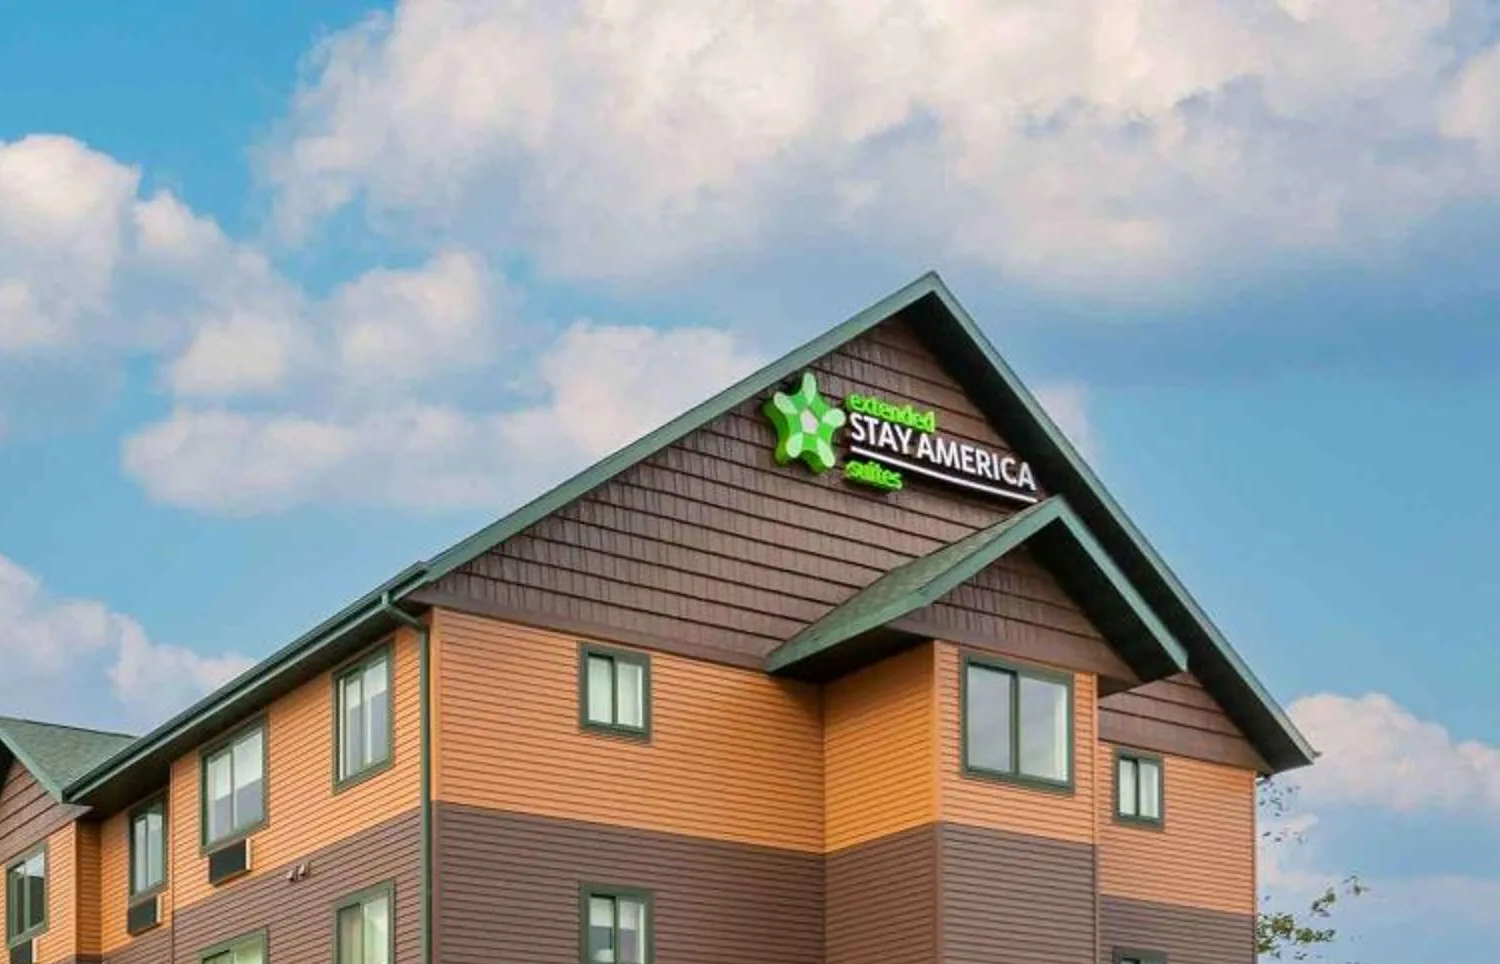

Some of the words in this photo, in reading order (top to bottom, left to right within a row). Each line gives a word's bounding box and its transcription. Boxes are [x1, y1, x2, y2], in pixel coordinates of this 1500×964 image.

[848, 394, 936, 433] extended
[850, 412, 912, 454] STAY
[917, 432, 1037, 491] AMERICA
[846, 460, 903, 490] suites
